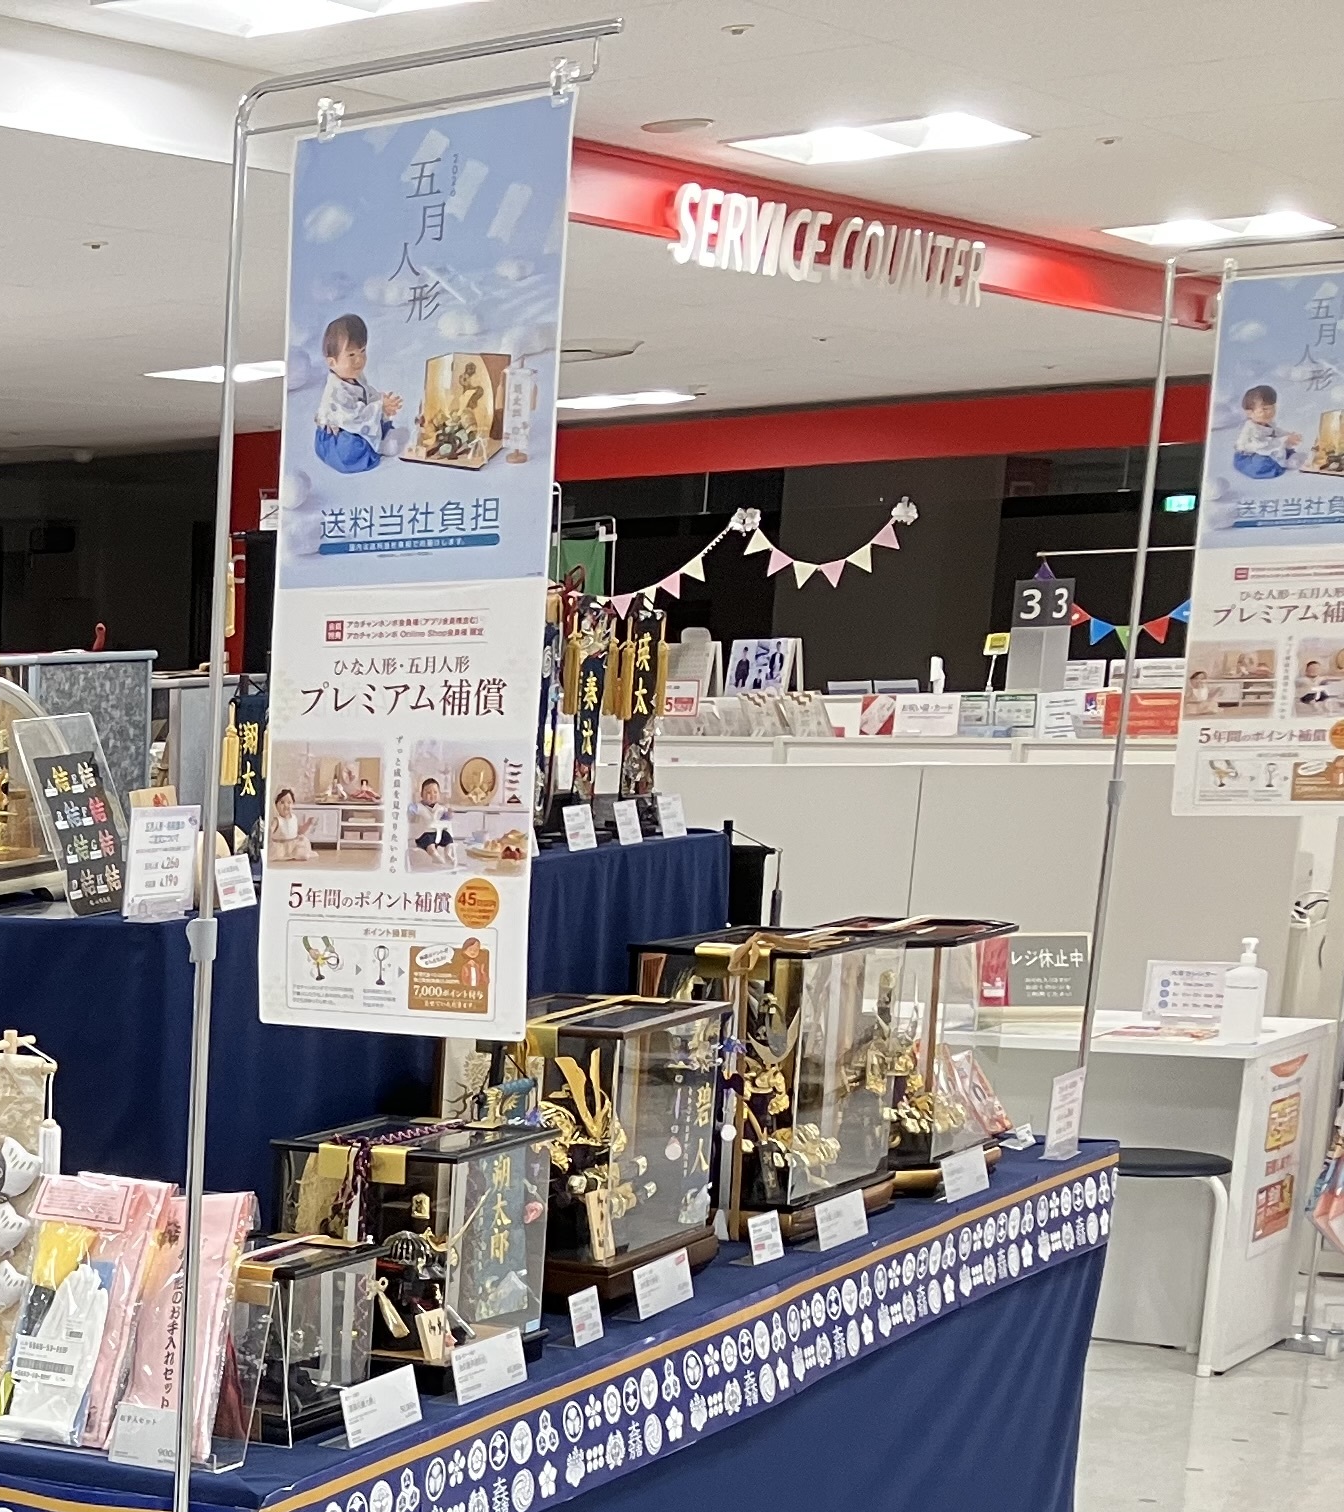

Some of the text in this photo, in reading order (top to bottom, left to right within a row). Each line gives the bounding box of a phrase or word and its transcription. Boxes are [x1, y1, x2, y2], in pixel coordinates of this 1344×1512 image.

[388, 158, 446, 323] 五月人形
[668, 182, 987, 308] SERVICE COUNTER
[1294, 297, 1339, 392] 五月人形
[319, 497, 501, 540] 送料当社負担
[333, 655, 470, 676] ひな人形・五月人形
[300, 677, 509, 717] プレミアム補償
[288, 882, 452, 914] 5年間のポイント補償
[1010, 948, 1085, 969] レジ休止中
